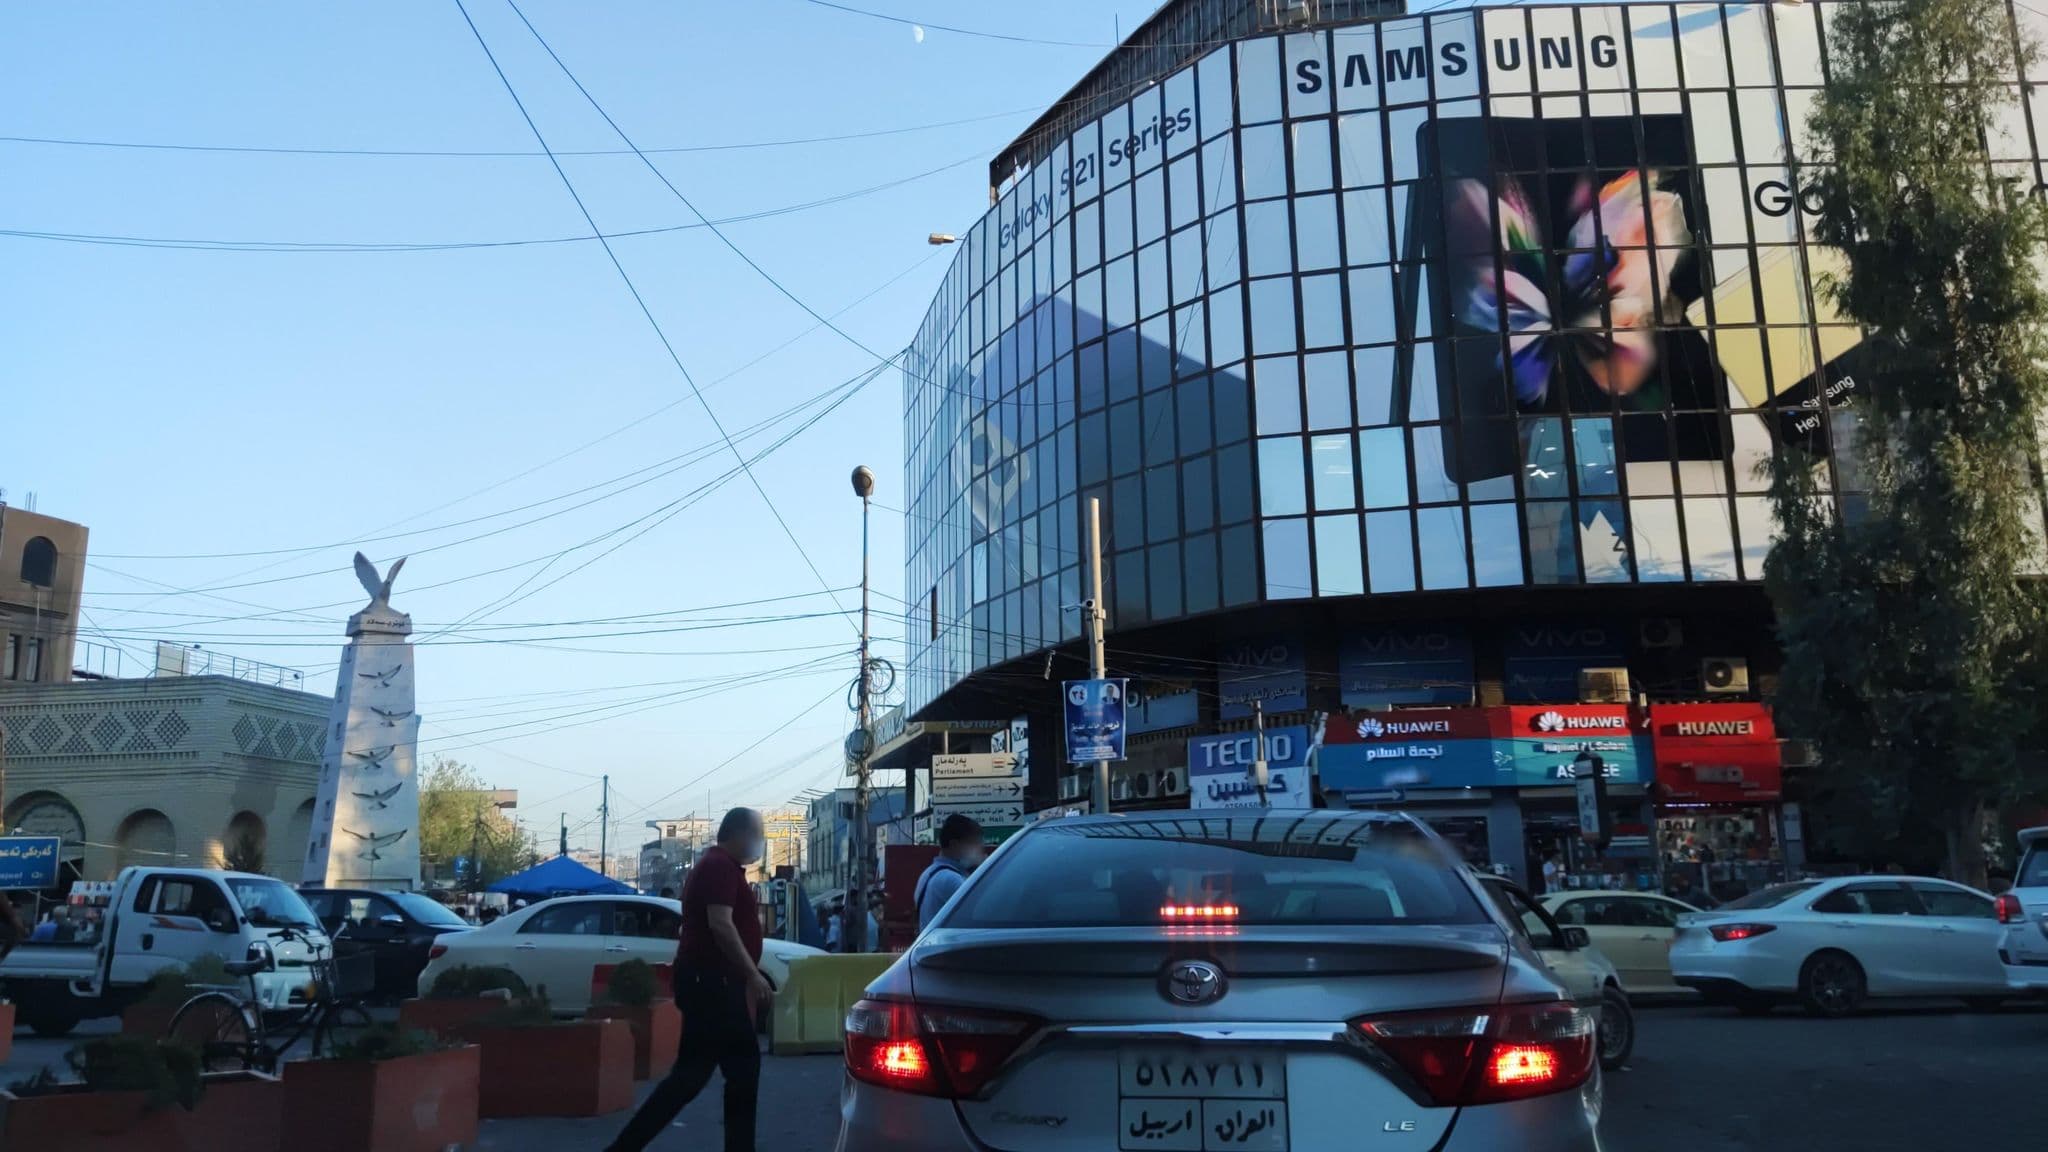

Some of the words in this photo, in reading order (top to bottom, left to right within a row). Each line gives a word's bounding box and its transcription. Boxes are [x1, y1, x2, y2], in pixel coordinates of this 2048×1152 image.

[1296, 35, 1618, 94] SAMSUNG
[1000, 193, 1051, 249] Galaxy
[1060, 153, 1095, 196] S21
[1108, 108, 1191, 167] Series
[1387, 721, 1449, 734] HUAWEI
[1567, 717, 1625, 728] HUAWEI
[1678, 720, 1753, 735] HUAWEI
[1201, 735, 1291, 767] TECNO
[1366, 747, 1405, 761] السلام
[1215, 1110, 1274, 1142] العراق
[1383, 1120, 1415, 1132] LE
